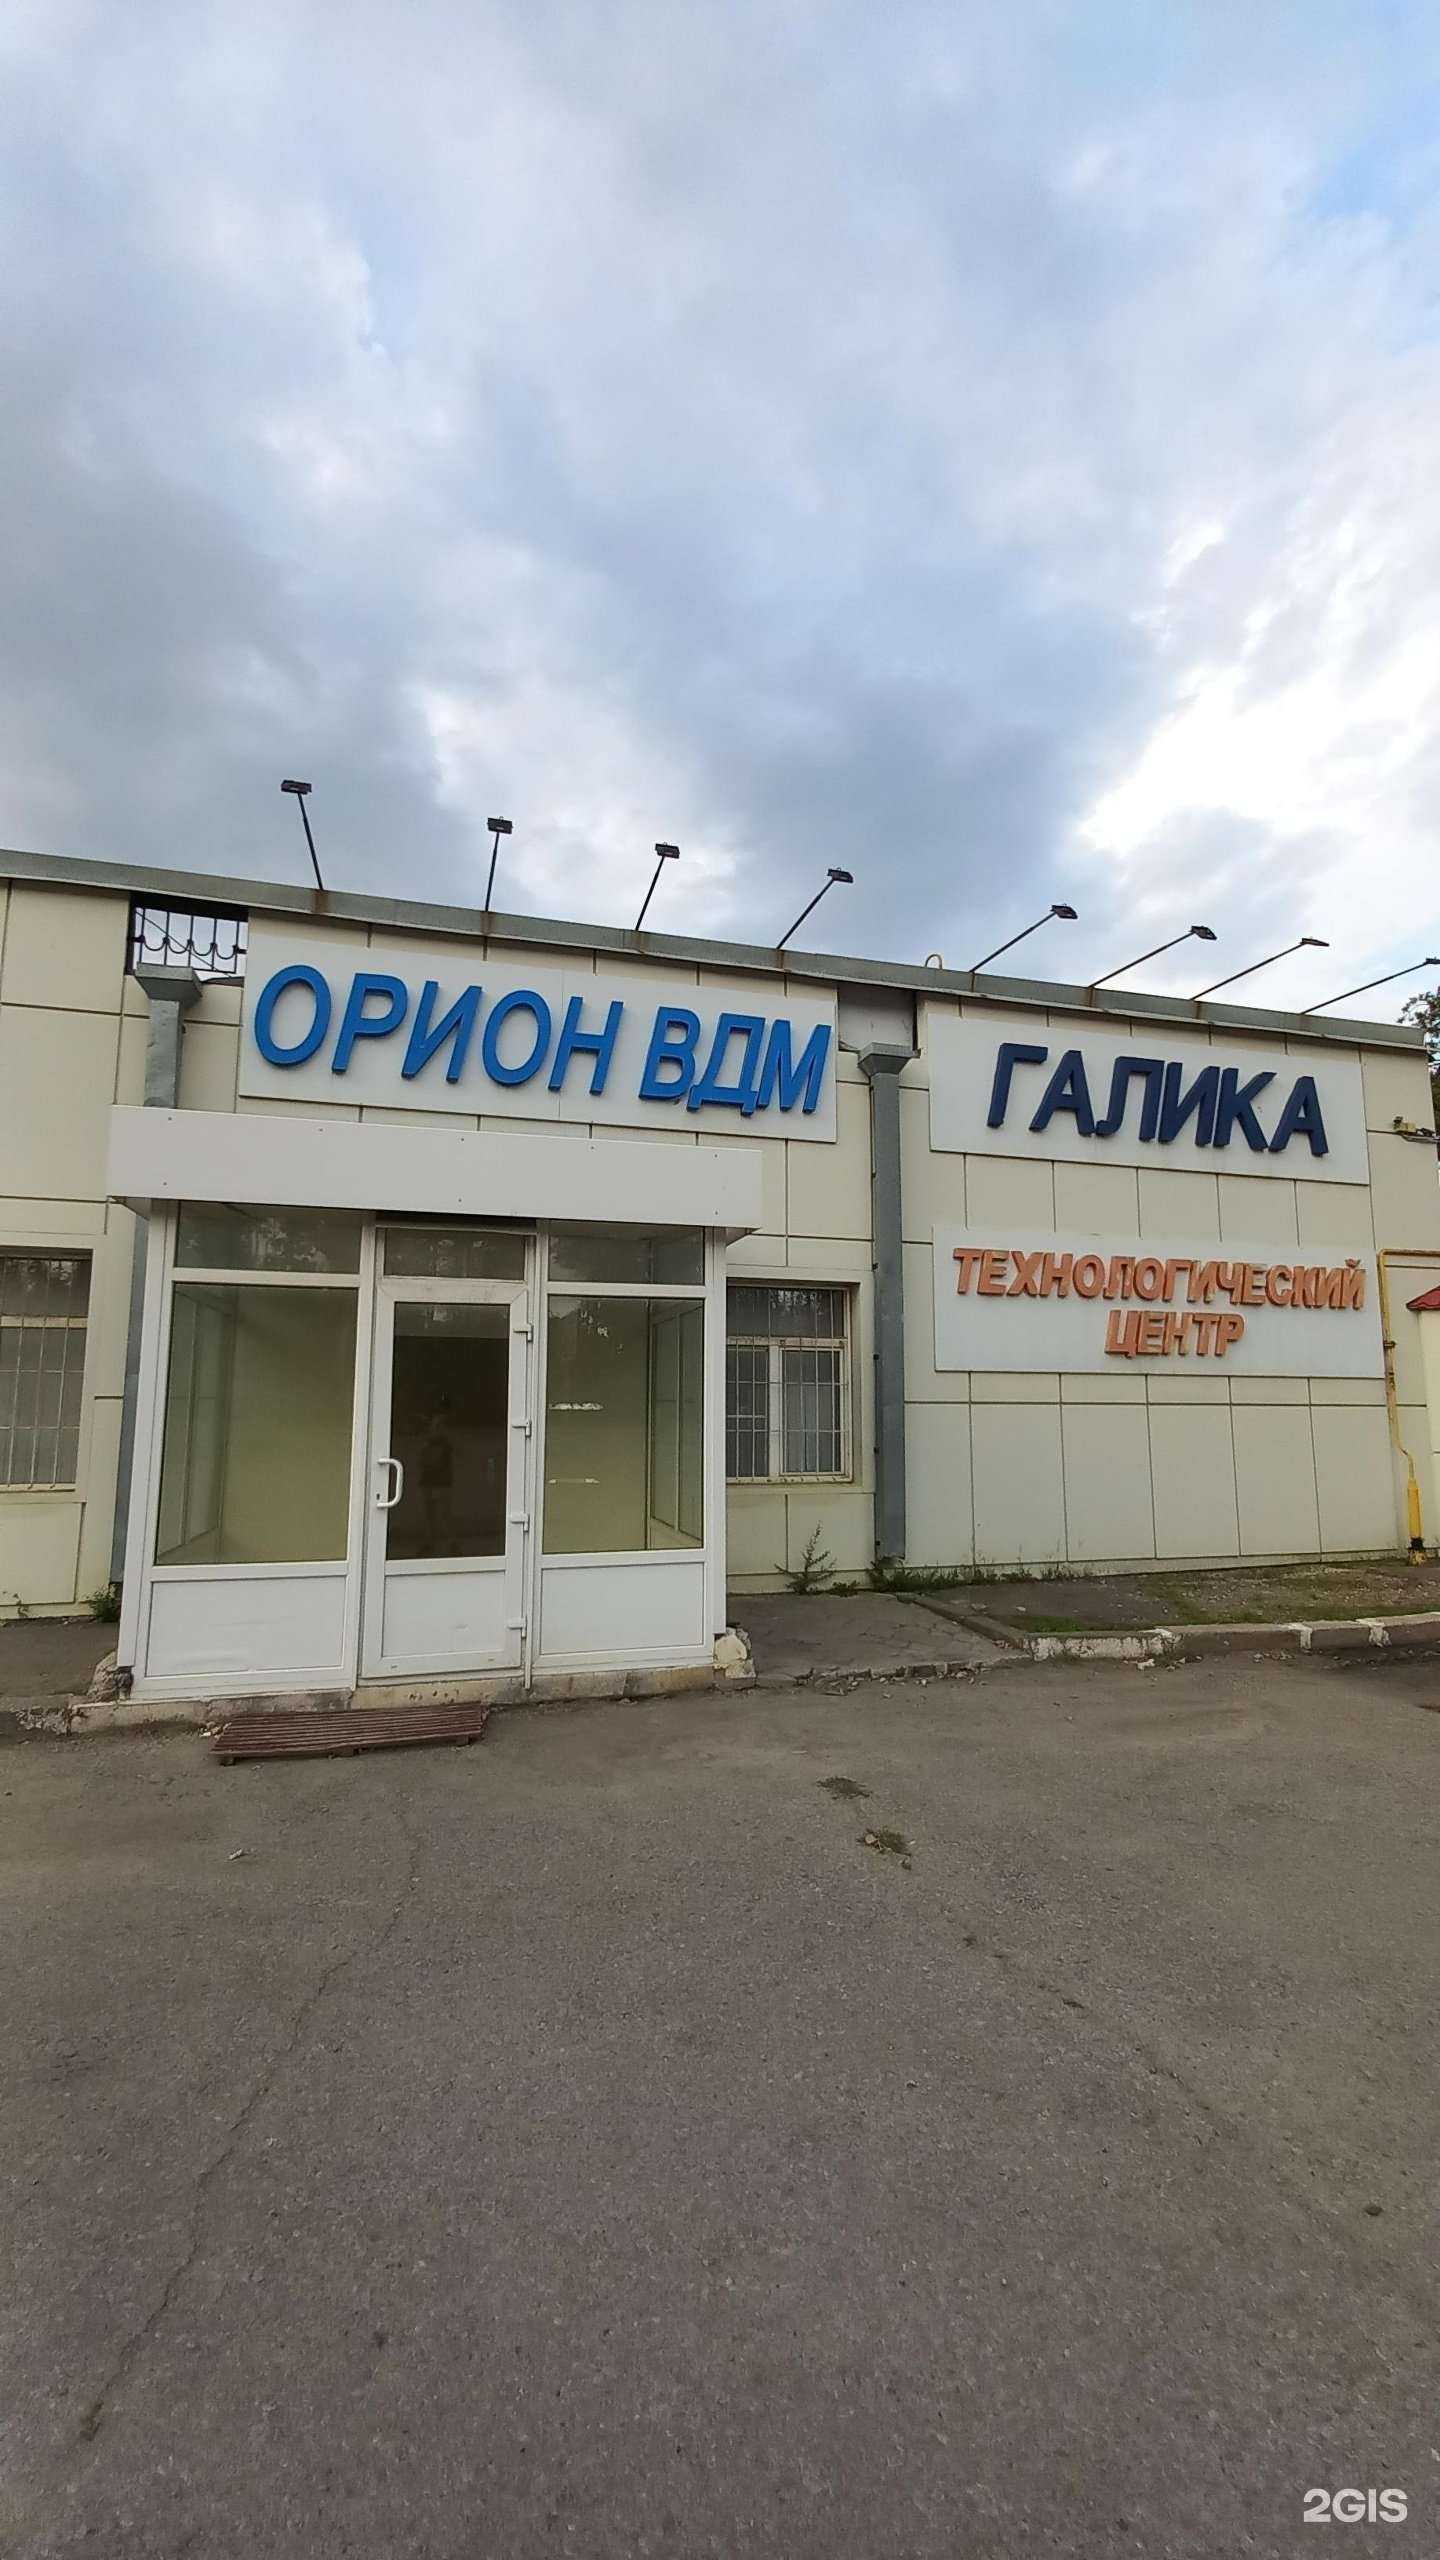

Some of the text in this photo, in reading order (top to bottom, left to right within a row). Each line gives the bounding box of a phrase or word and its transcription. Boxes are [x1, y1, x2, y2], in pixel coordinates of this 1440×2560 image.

[254, 964, 832, 1116] ОРИОН ВДМ
[986, 1042, 1329, 1157] ГАЛИКА
[953, 1247, 1367, 1310] ТЕХНОЛОГИЧЕСКИЙ
[1105, 1309, 1246, 1358] ЦЕНТР
